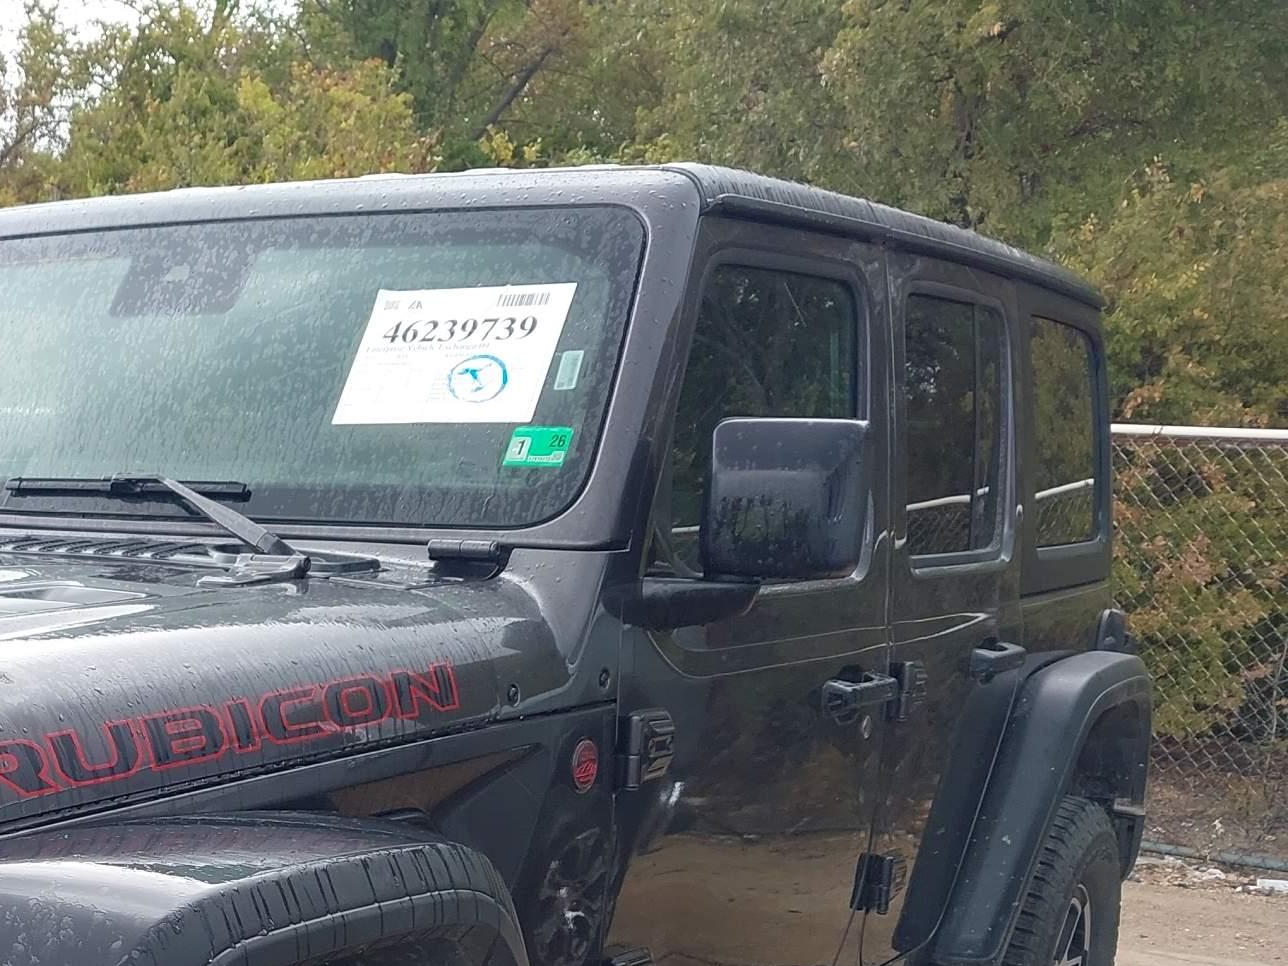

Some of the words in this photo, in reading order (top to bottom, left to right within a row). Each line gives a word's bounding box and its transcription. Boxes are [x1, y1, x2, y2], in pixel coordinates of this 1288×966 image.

[383, 316, 538, 344] 46239739
[517, 440, 526, 456] 1
[550, 434, 567, 448] 26
